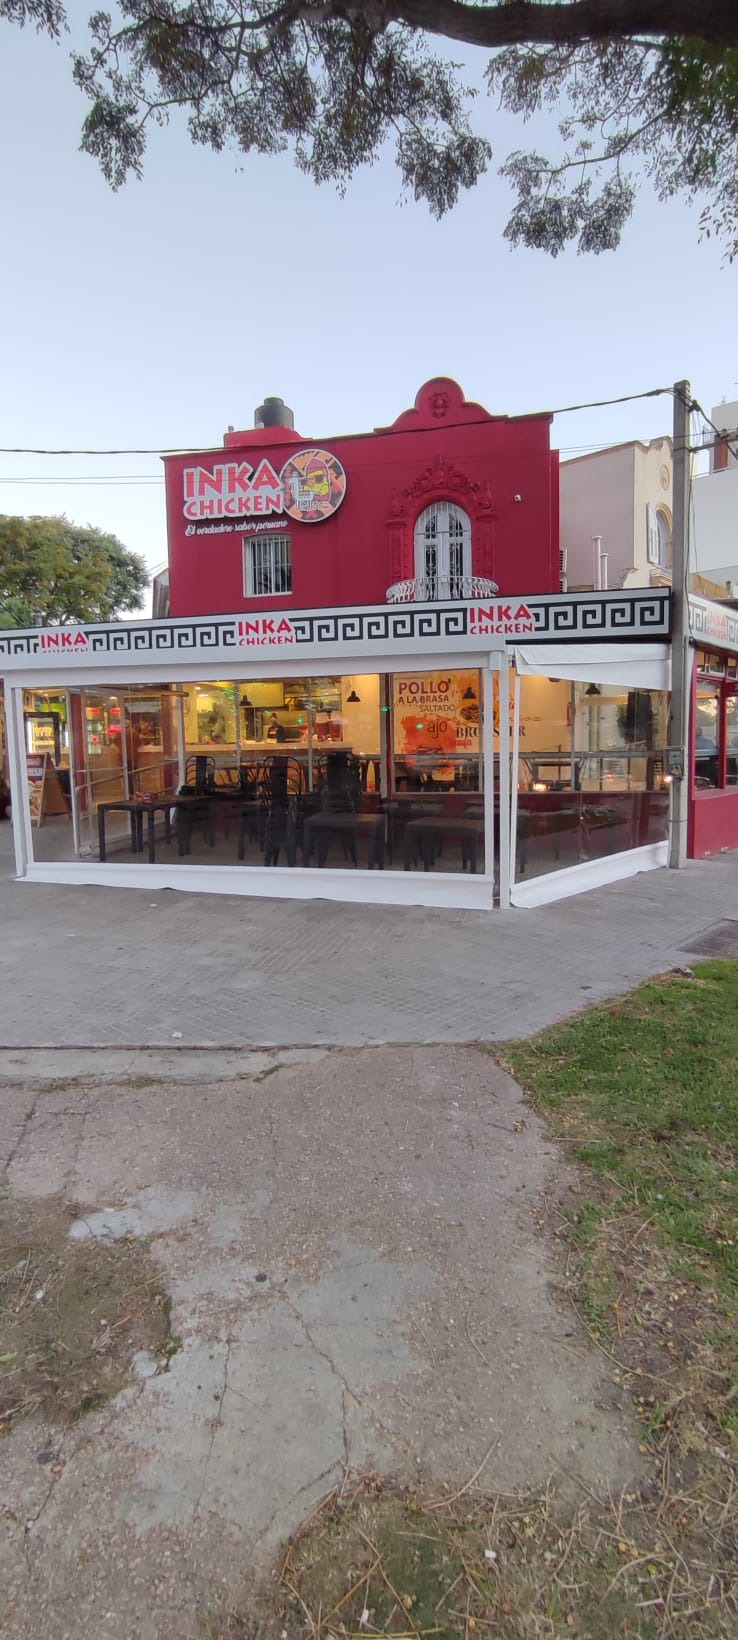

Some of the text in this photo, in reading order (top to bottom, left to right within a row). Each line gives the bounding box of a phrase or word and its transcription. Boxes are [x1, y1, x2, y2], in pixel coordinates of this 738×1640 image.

[185, 461, 282, 499] INKA
[185, 493, 282, 518] CHICKEN
[185, 520, 288, 537] El verdadero sabor peruano
[469, 603, 532, 624] INKA
[237, 617, 293, 636] INKA
[469, 622, 533, 635] CHICKEN
[40, 631, 88, 649] INKA
[238, 635, 294, 646] CHICKEN
[398, 680, 450, 695] POLLO
[398, 694, 450, 704] A LA BRASA
[419, 704, 456, 713] SALTADO
[427, 719, 448, 739] ajo
